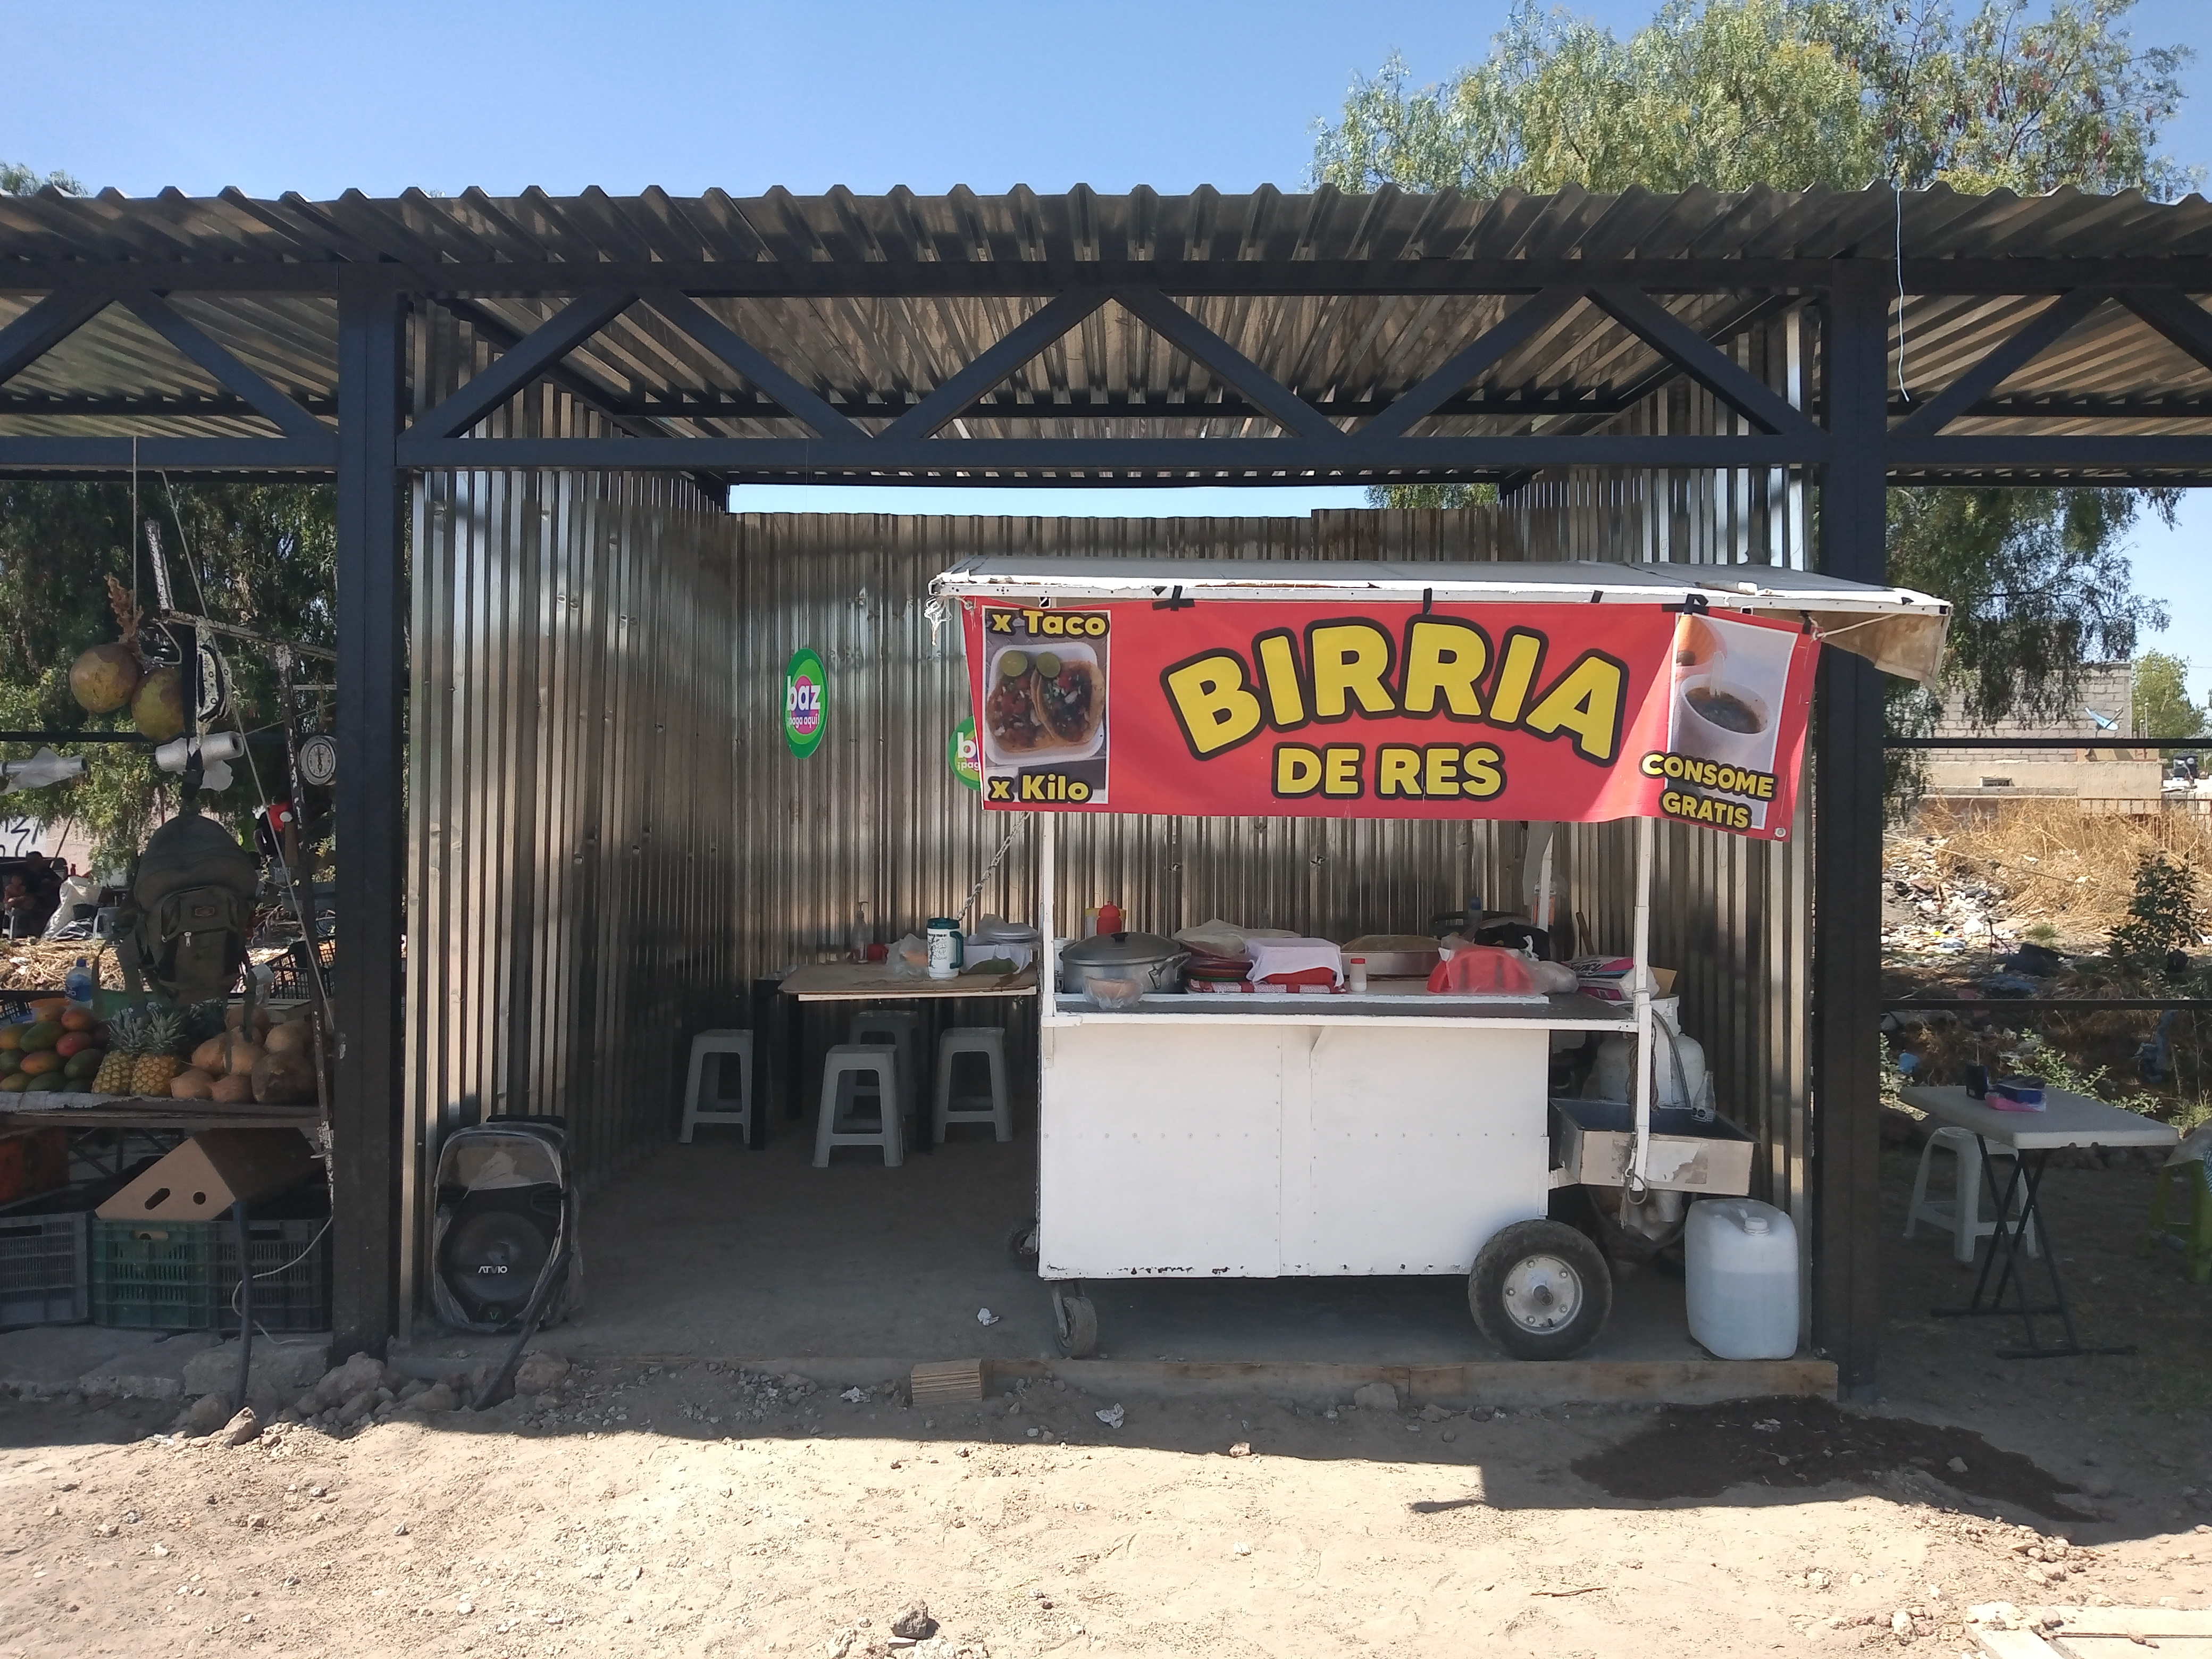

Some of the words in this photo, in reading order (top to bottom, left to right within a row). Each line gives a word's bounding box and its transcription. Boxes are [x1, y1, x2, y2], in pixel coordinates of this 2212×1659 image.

[992, 614, 1012, 633] x
[1023, 610, 1106, 636] Taco
[787, 675, 821, 711] baz
[1167, 622, 1621, 760] BIRRIA
[991, 780, 1011, 799] x
[1022, 774, 1089, 801] Kilo
[1277, 748, 1360, 794] DE
[1380, 747, 1502, 796] RES
[1641, 754, 1774, 798] CONSOME
[1662, 792, 1749, 828] GRATIS
